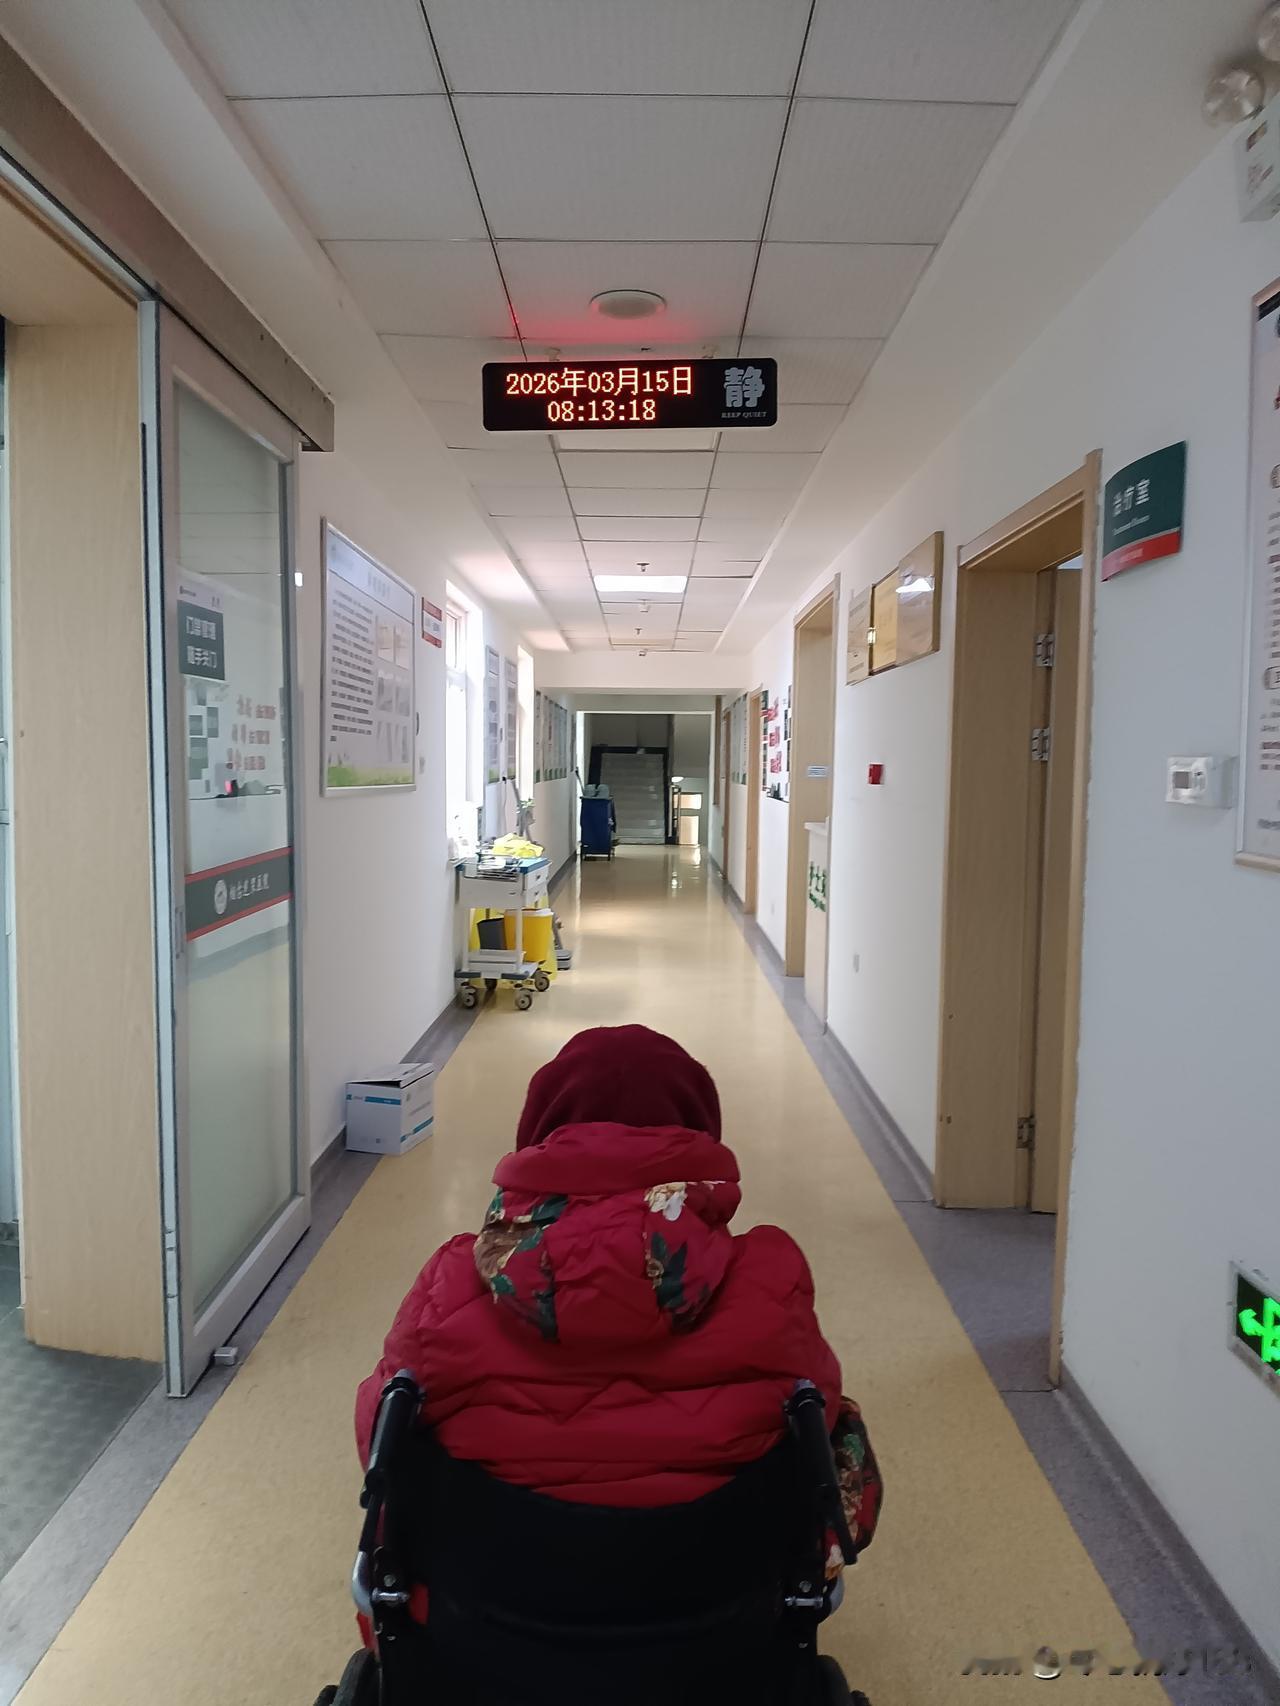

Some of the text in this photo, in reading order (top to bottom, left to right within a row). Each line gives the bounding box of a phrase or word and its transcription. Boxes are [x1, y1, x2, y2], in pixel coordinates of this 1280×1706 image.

[506, 366, 693, 396] 2026年03月15日
[723, 366, 766, 408] 静
[547, 399, 656, 422] 08:13:18
